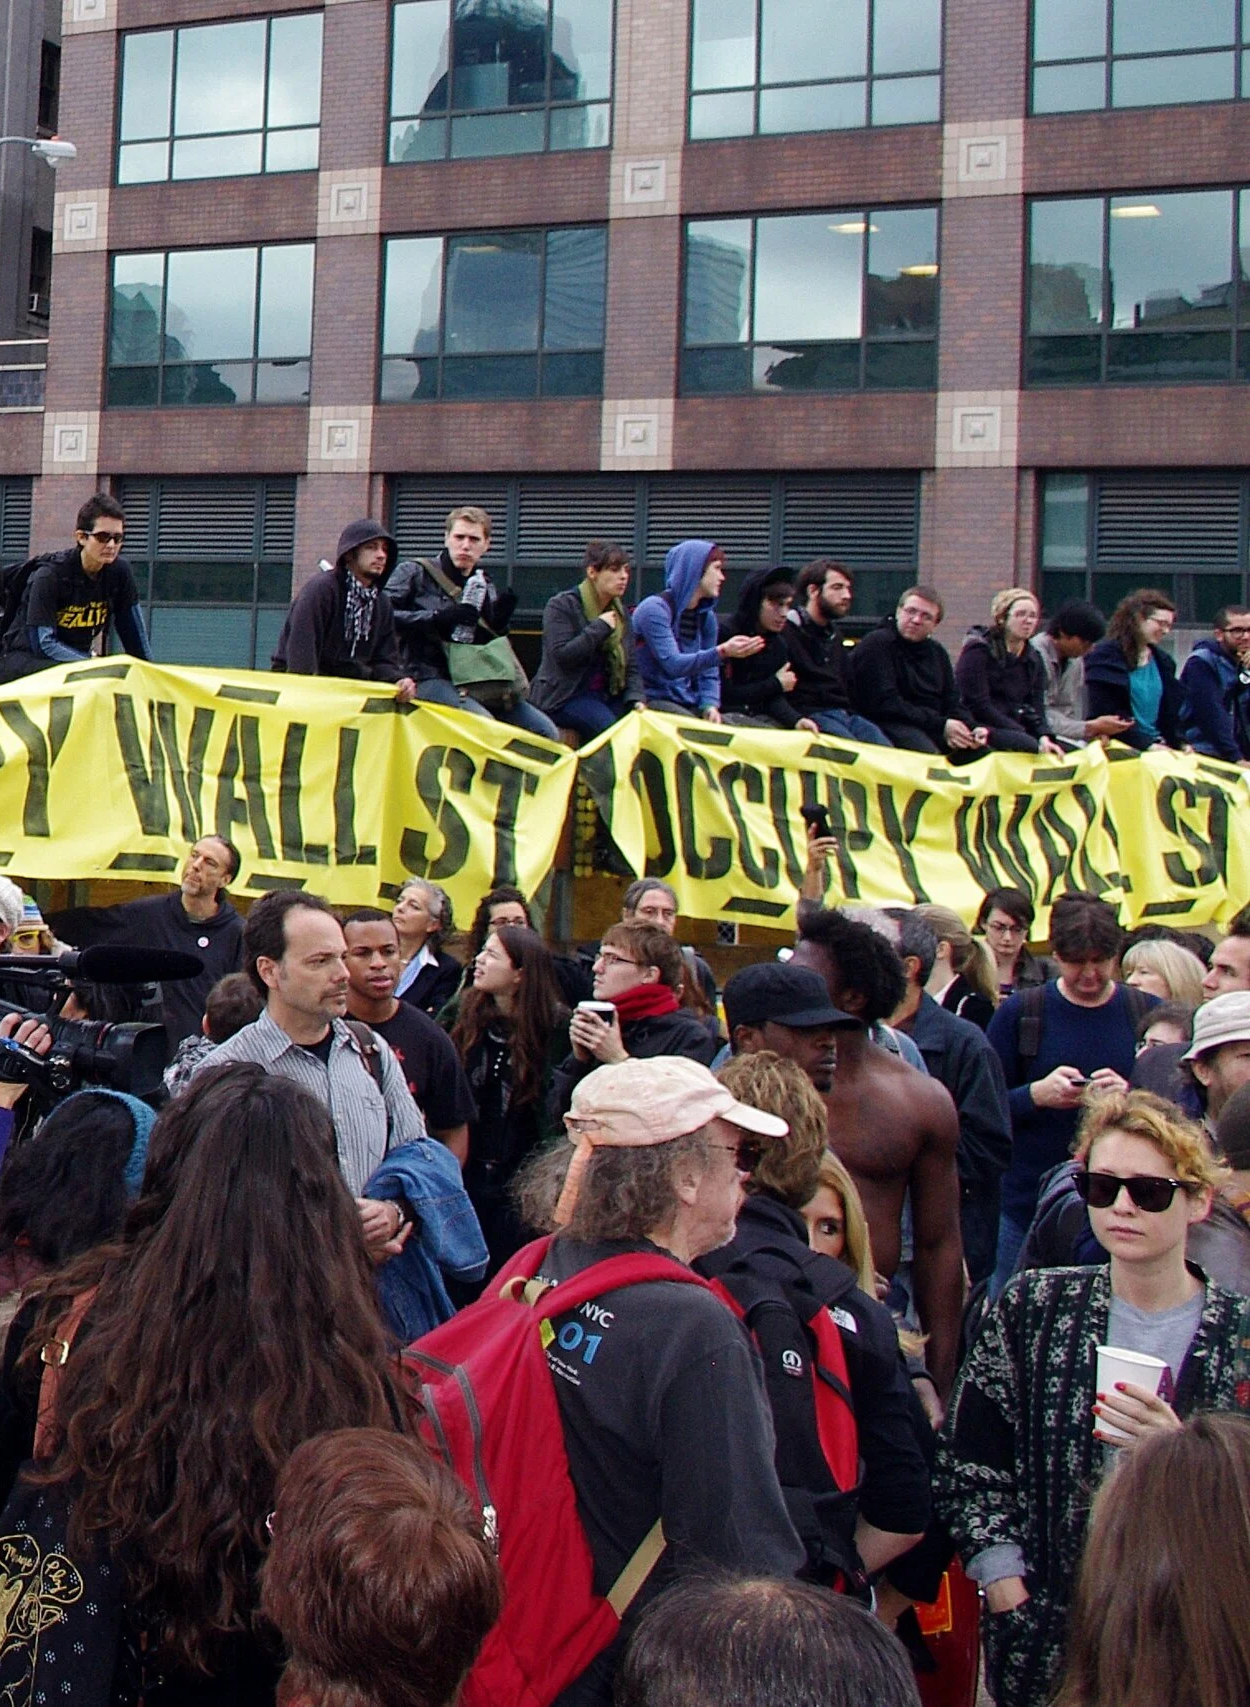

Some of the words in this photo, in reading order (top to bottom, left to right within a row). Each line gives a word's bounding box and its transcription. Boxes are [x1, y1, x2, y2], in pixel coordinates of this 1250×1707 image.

[113, 692, 378, 865] WALL
[399, 744, 540, 889] ST
[630, 748, 934, 904] OCCUPY
[558, 1321, 603, 1365] 01
[579, 1301, 615, 1329] NYC
